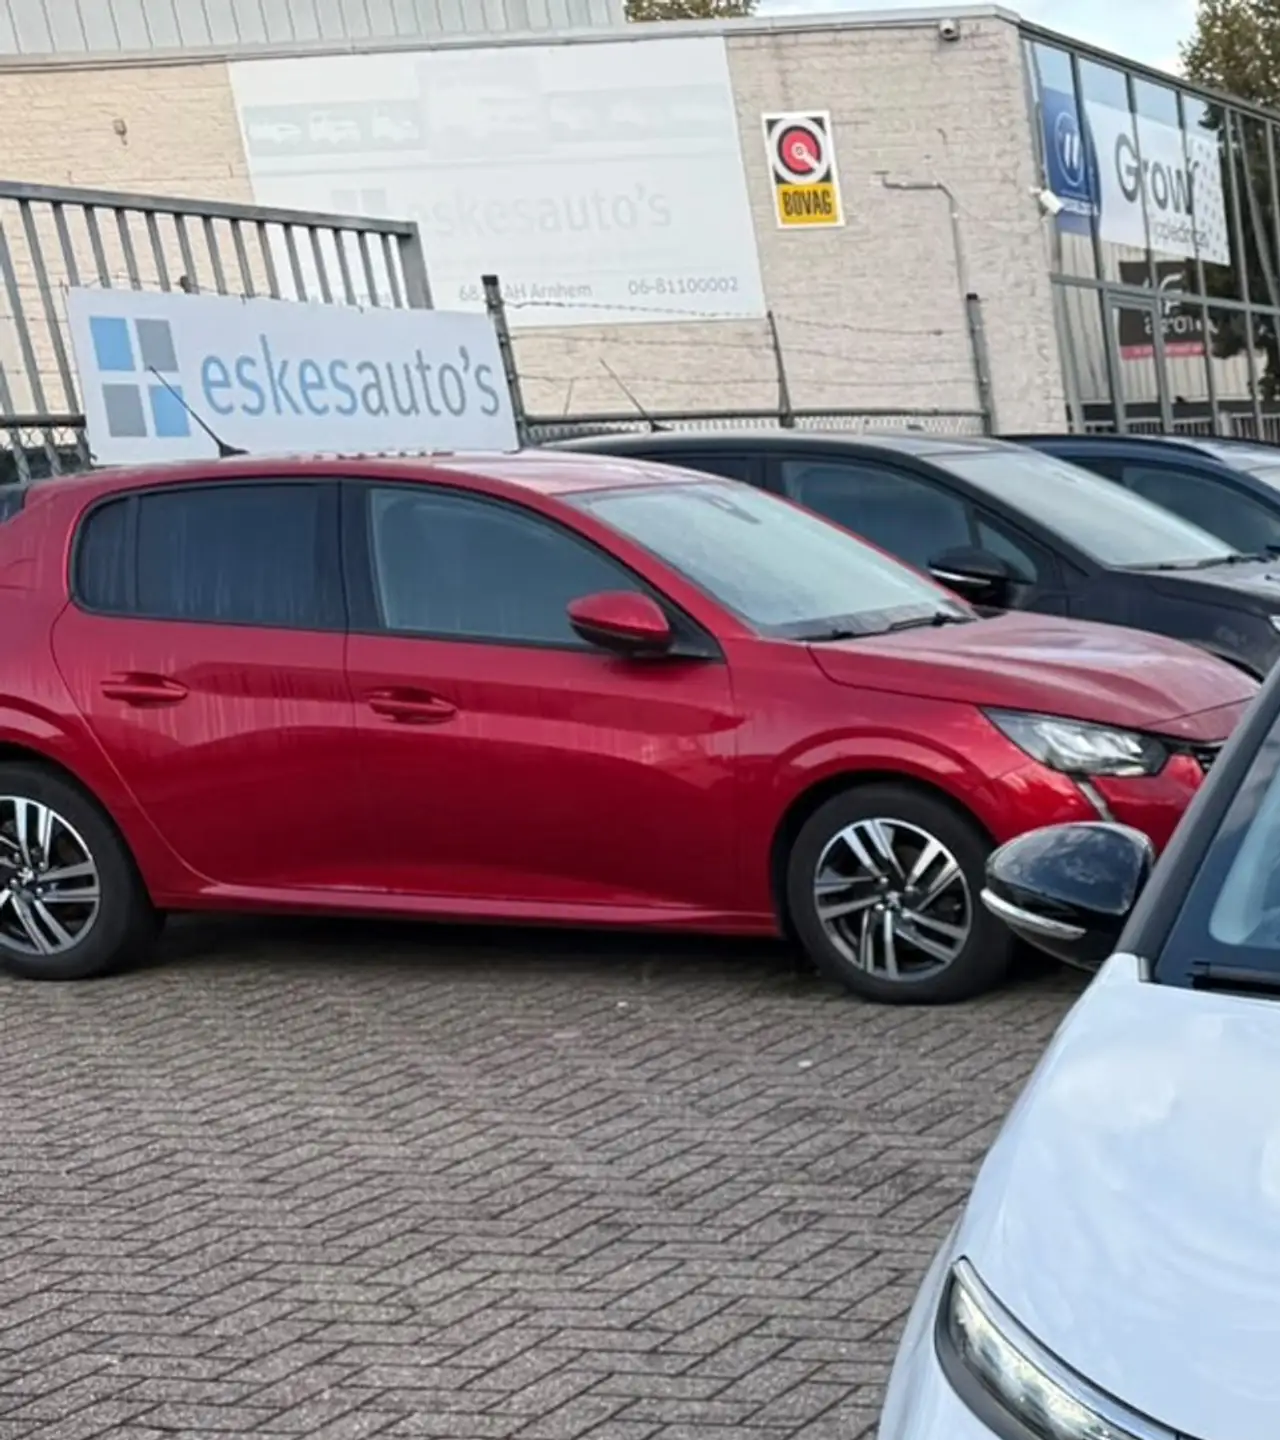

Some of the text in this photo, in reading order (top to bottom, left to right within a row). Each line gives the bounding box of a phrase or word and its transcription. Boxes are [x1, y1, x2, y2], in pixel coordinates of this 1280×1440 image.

[782, 189, 833, 216] BOVAG
[530, 282, 593, 300] Arnhem
[201, 333, 500, 416] eskesauto's
